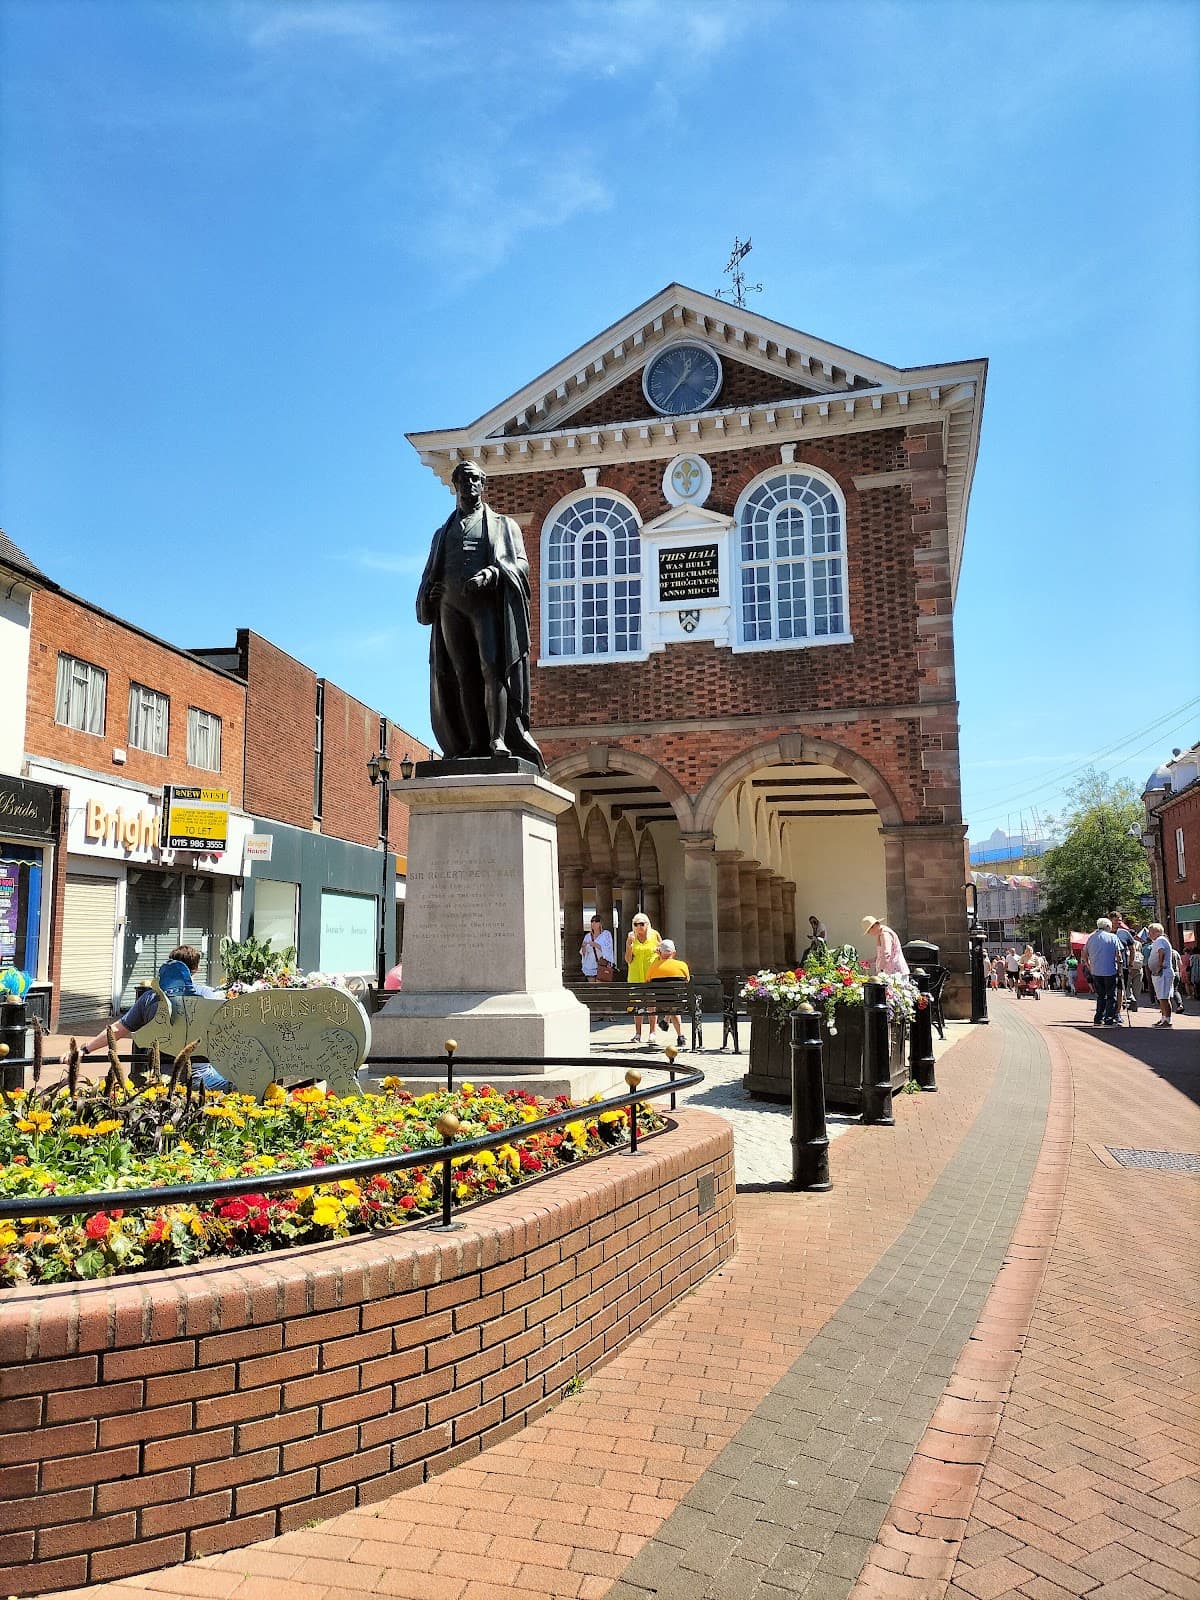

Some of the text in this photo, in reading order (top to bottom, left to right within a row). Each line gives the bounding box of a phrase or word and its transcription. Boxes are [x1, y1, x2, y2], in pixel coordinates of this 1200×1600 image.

[660, 550, 716, 562] THIS HALL
[685, 560, 712, 568] BUILT
[670, 571, 686, 579] THE
[686, 569, 718, 577] CHARGE
[663, 589, 685, 597] ANNO
[180, 789, 225, 800] NEW WEST
[185, 826, 213, 836] TO LET
[171, 838, 224, 849] 0115 986 3555
[247, 847, 268, 855] House
[222, 1001, 251, 1020] THE
